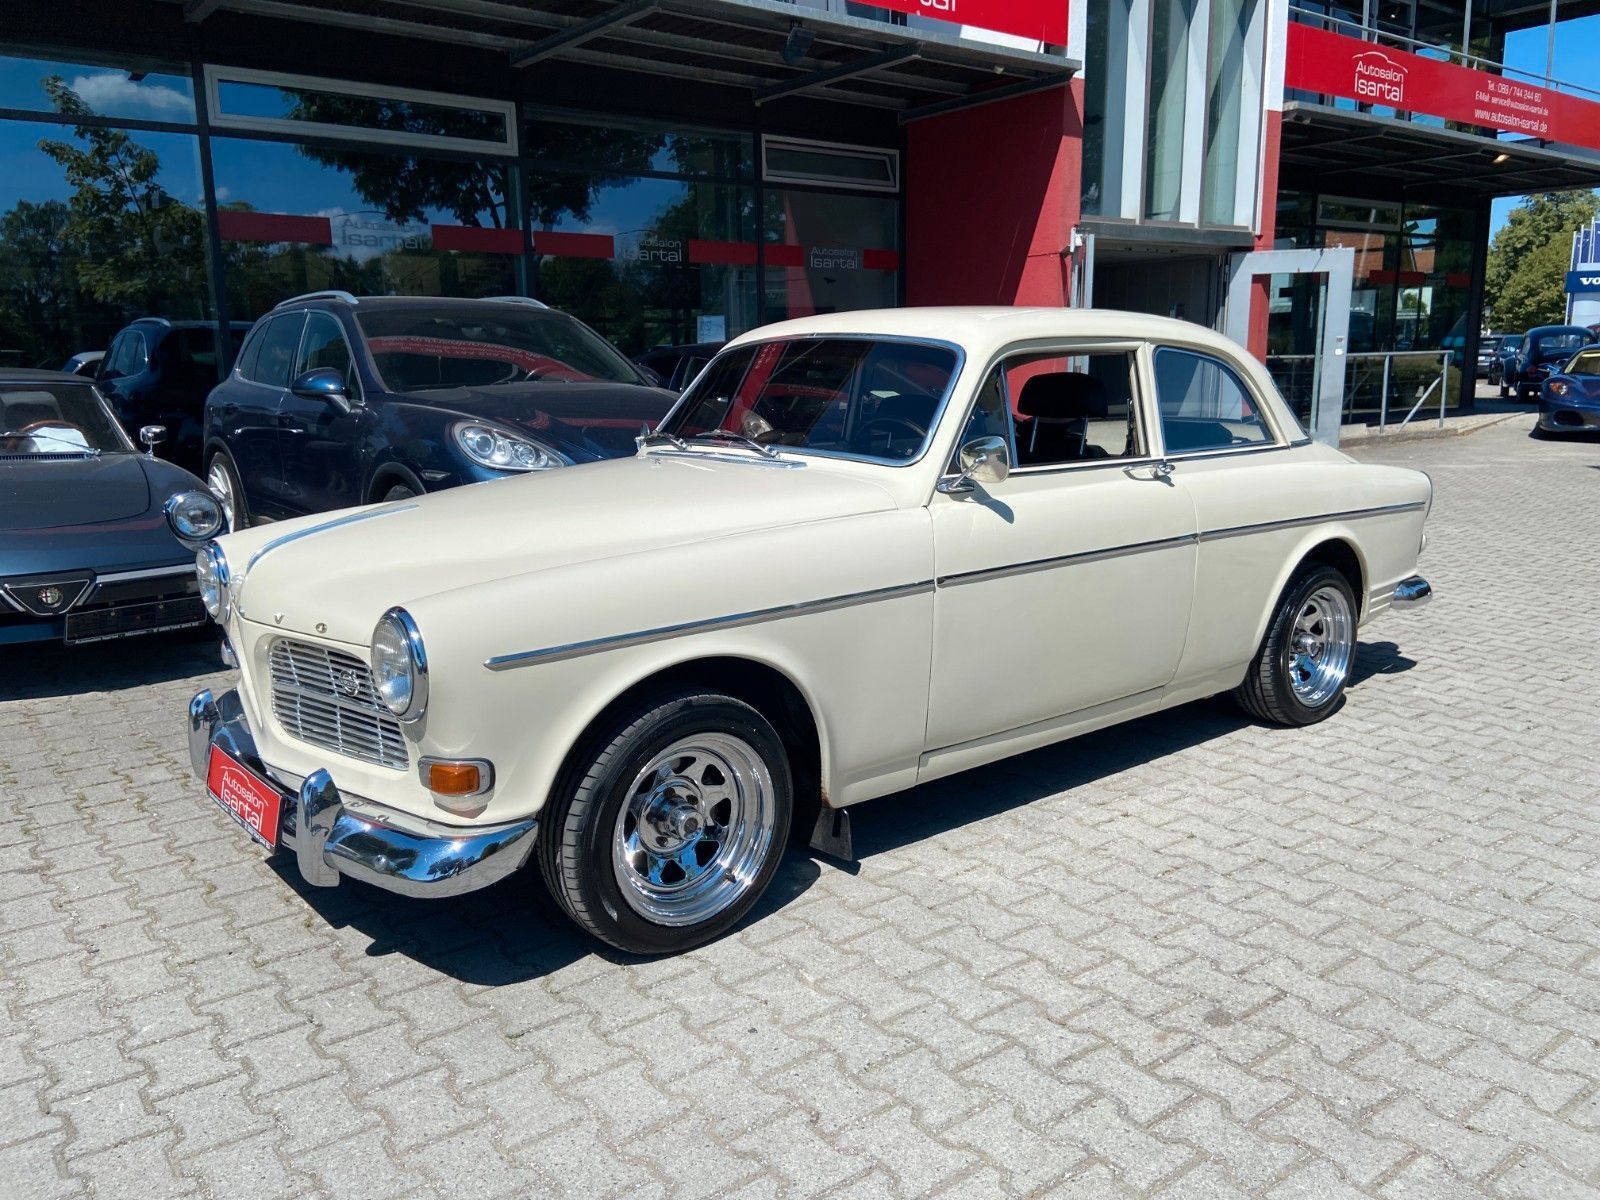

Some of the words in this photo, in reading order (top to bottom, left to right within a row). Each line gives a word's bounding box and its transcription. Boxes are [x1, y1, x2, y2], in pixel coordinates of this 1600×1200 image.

[1356, 60, 1404, 83] Autosalon
[1354, 73, 1403, 102] Isartal
[1498, 83, 1508, 95] 089
[810, 255, 858, 269] Isartal
[222, 770, 265, 811] Autosalon
[220, 780, 265, 833] Isartal
